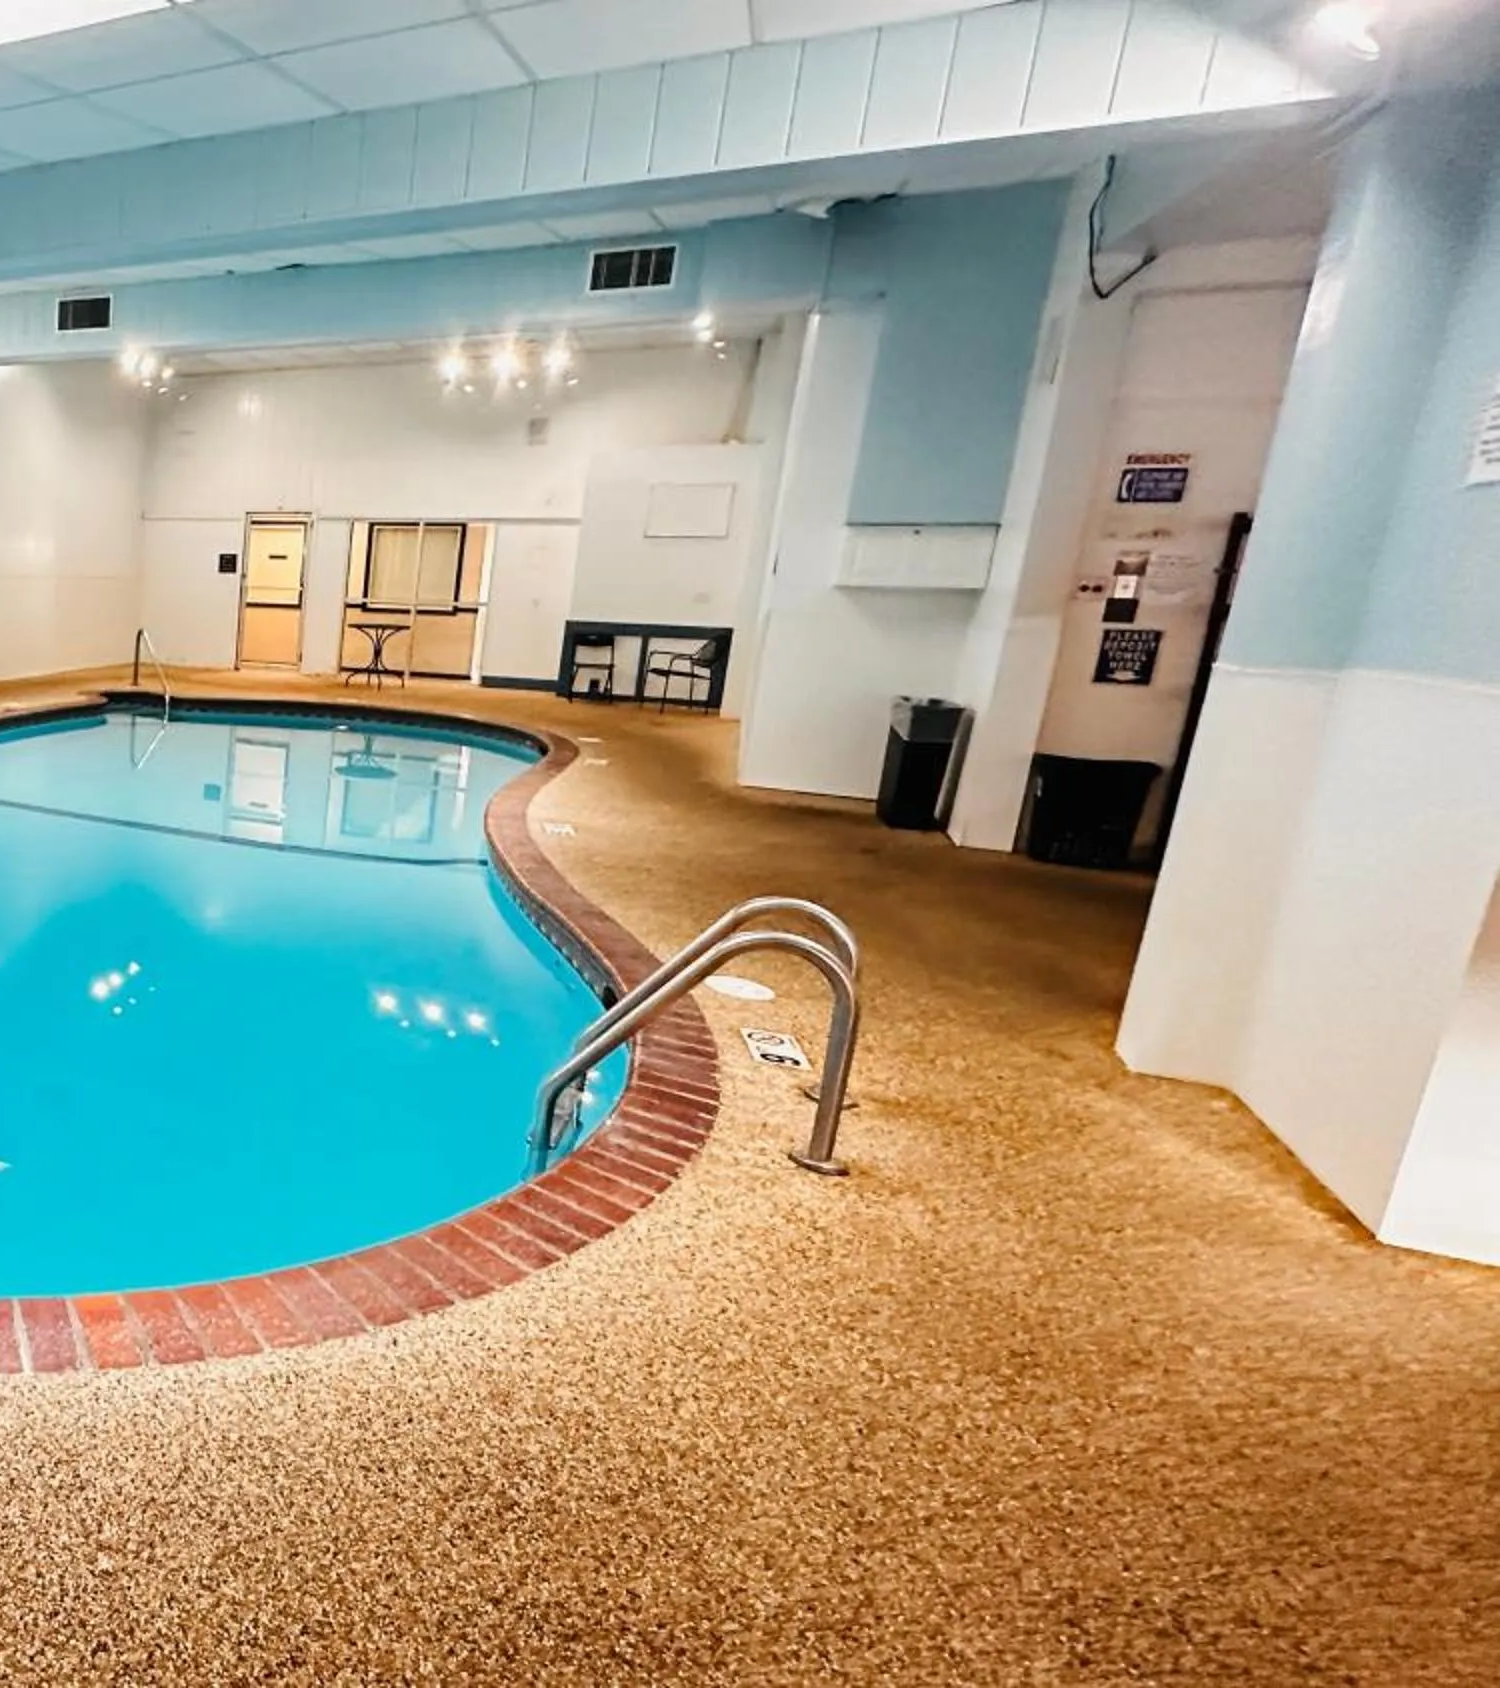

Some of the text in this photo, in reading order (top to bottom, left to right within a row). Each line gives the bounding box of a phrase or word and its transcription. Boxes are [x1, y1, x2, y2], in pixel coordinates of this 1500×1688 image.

[1126, 454, 1192, 465] EMERGENCY
[1108, 631, 1156, 641] PLEASE
[1103, 641, 1157, 651] DEPOSIT
[1108, 651, 1147, 662] TOWEL
[1108, 661, 1142, 671] HERE
